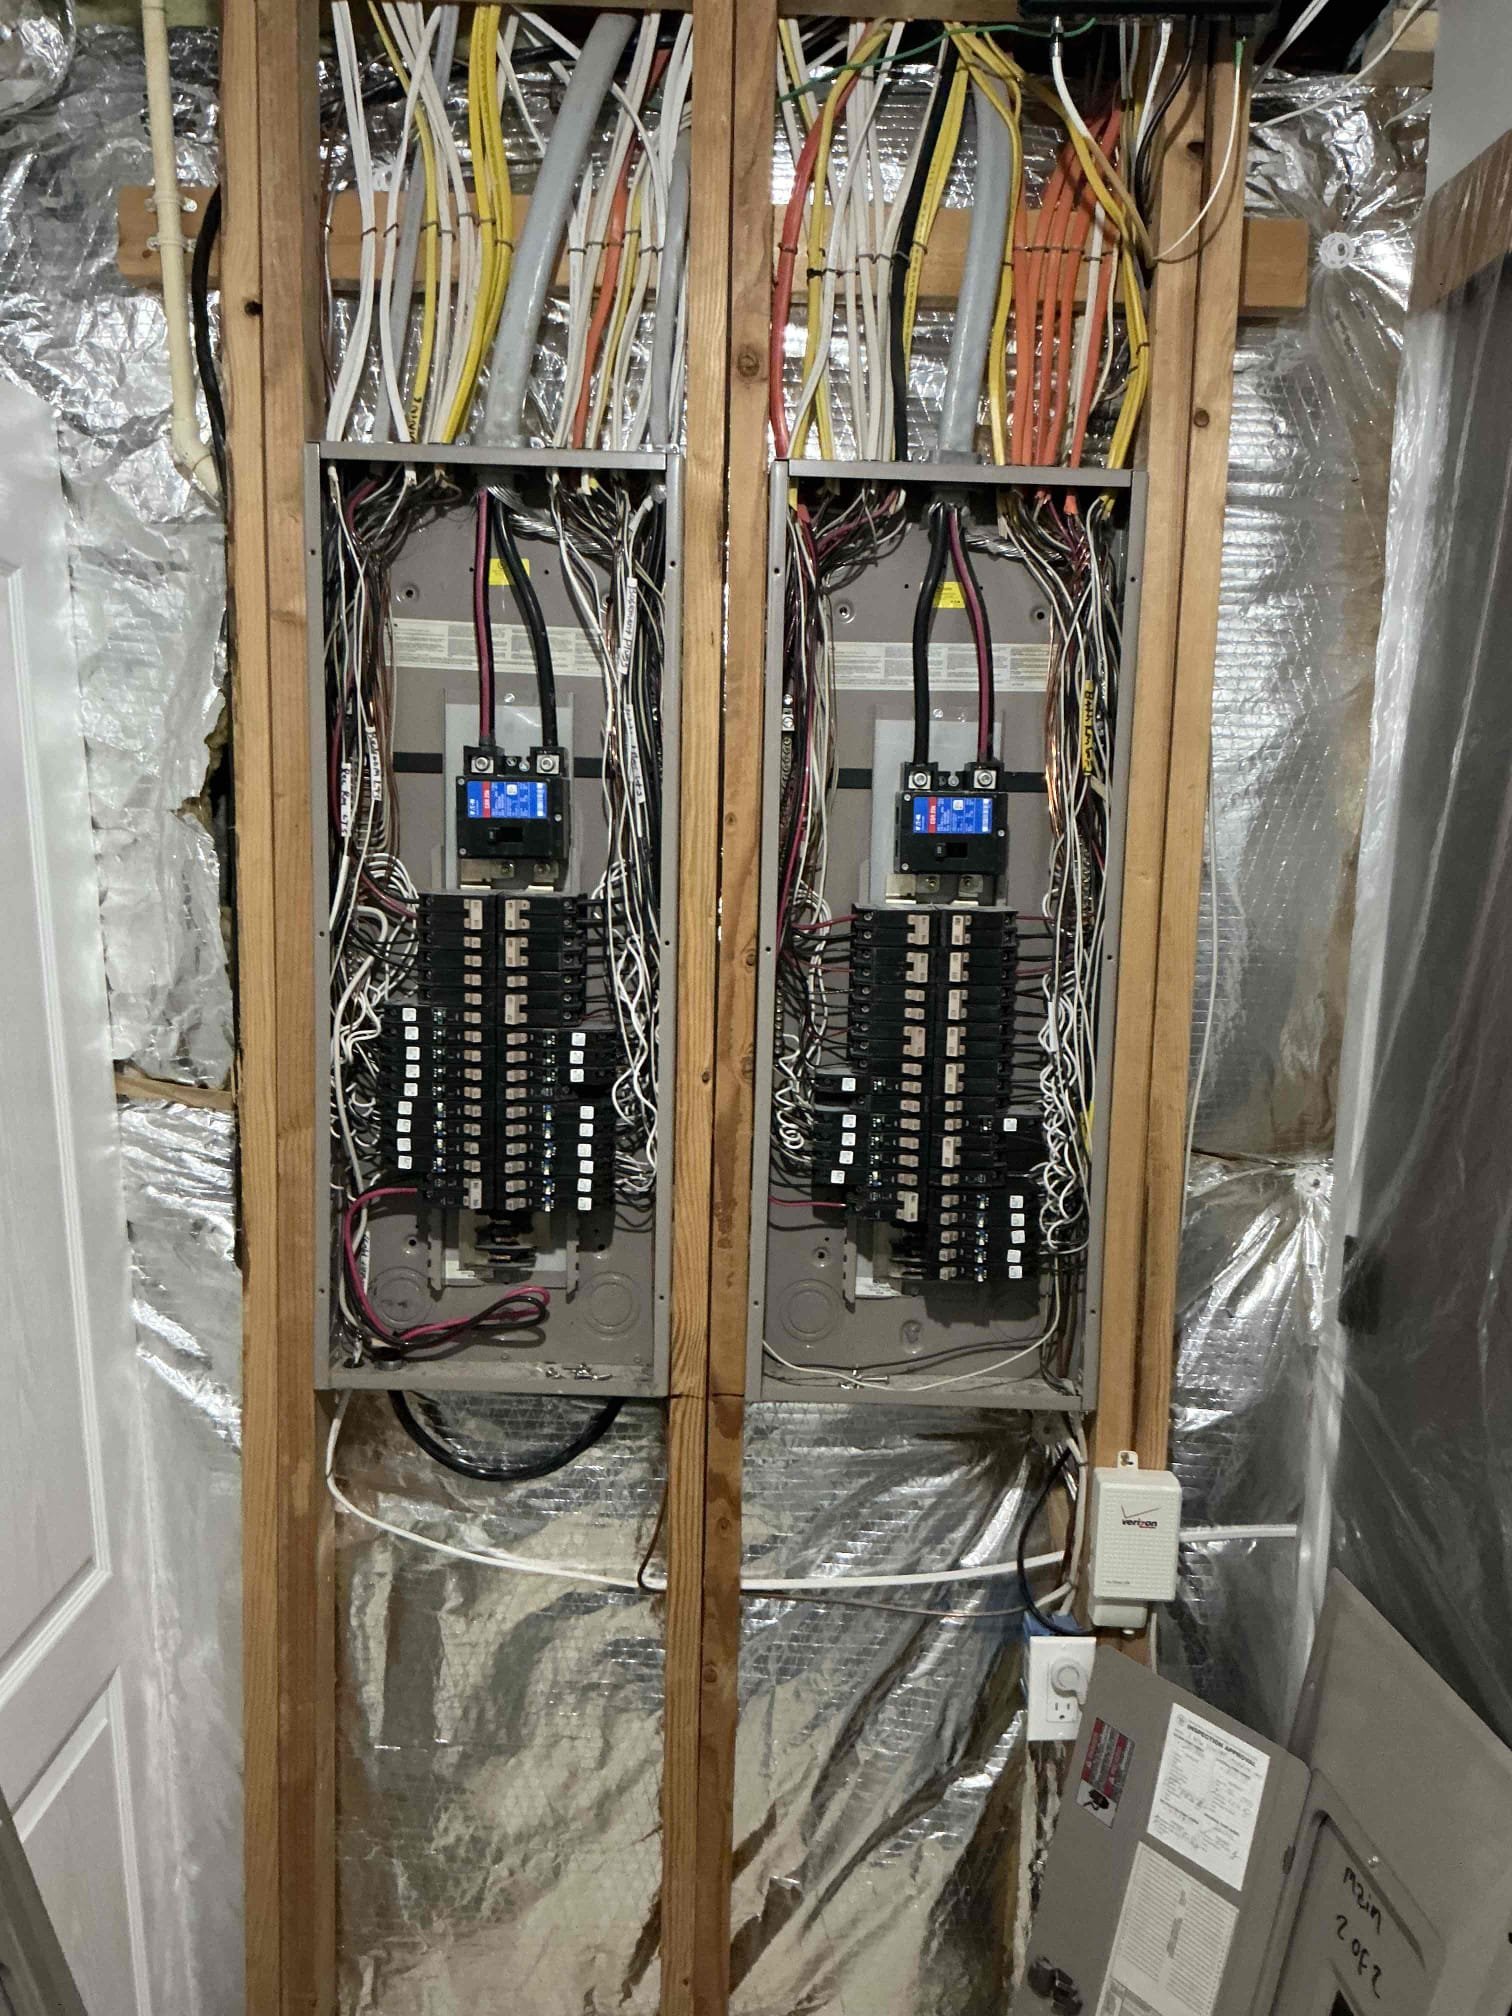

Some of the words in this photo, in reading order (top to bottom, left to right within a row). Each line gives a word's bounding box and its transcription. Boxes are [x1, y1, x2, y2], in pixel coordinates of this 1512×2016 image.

[1121, 1517, 1158, 1528] verizon
[1187, 1724, 1224, 1748] INSPECTION
[1224, 1745, 1257, 1768] APPROVAL
[1336, 1914, 1349, 1941] 2
[1371, 1964, 1383, 2000] 2
